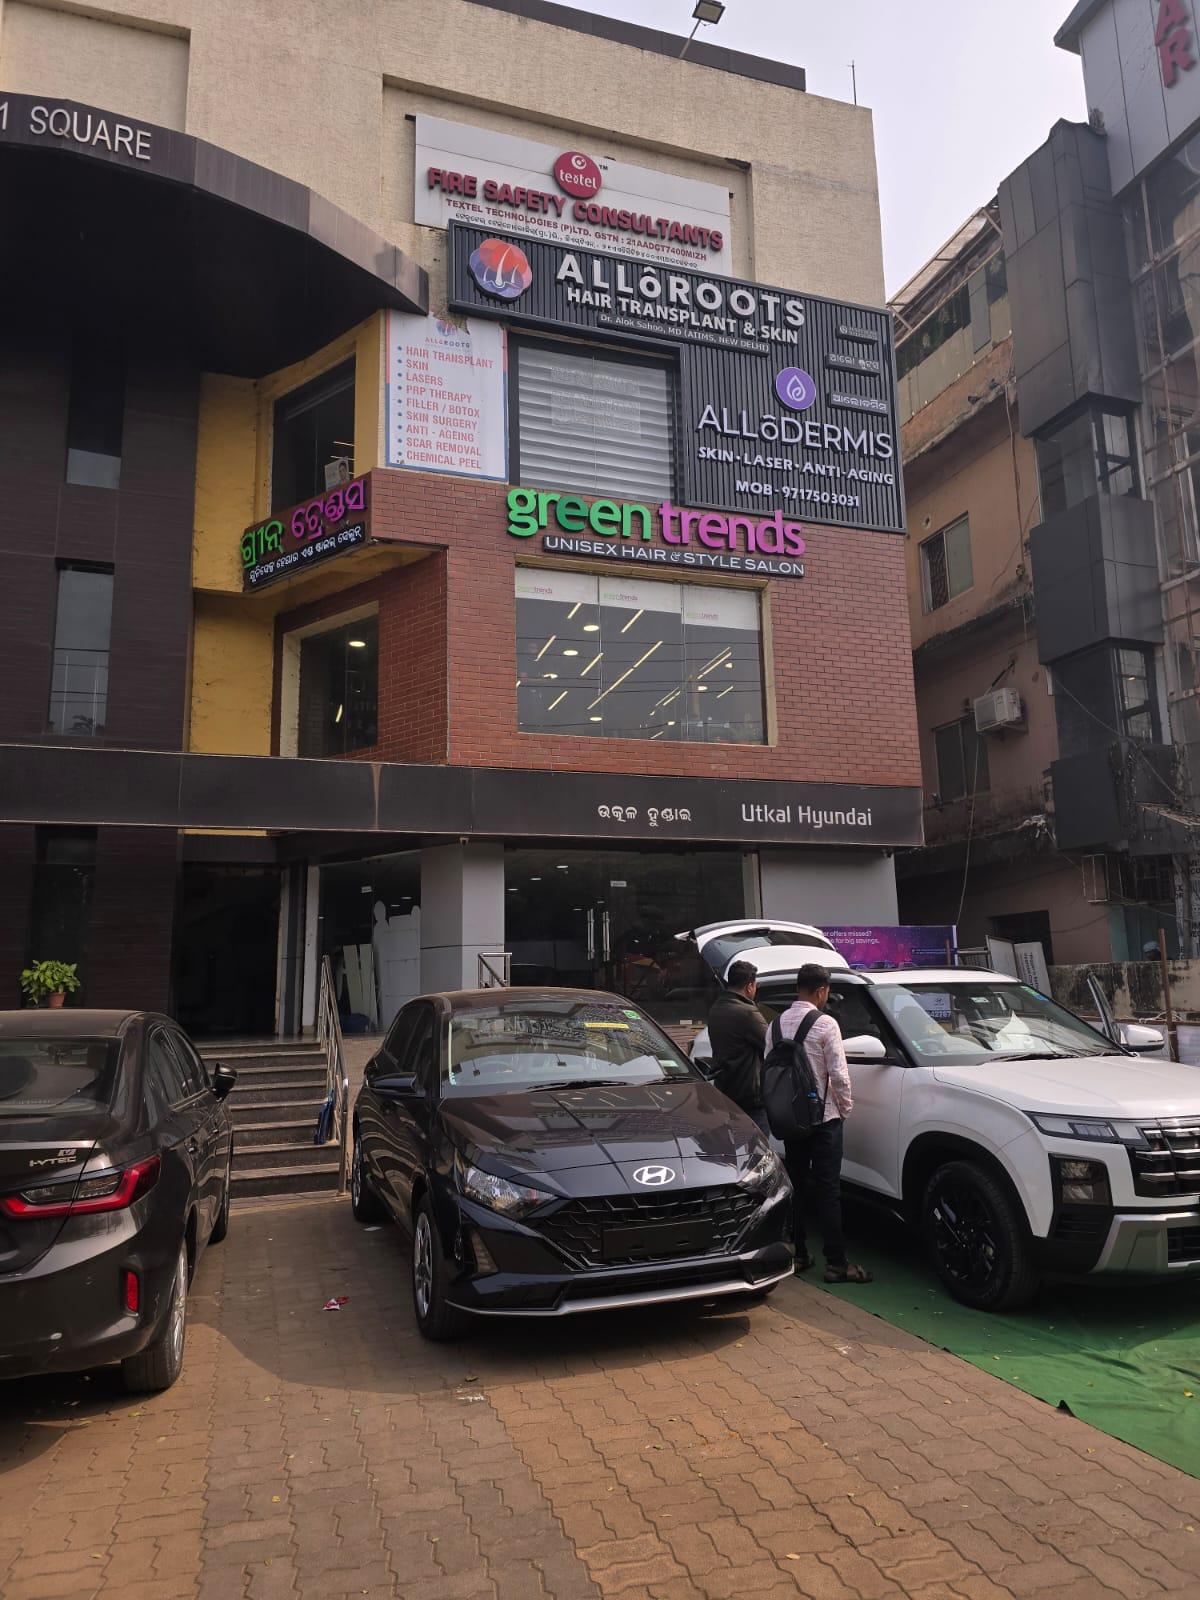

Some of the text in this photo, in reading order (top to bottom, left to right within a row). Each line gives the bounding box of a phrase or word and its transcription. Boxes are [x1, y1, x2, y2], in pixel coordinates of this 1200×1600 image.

[29, 106, 152, 161] SQUARE
[427, 167, 478, 199] FIRE
[484, 180, 567, 217] SAFETY
[573, 200, 724, 252] CONSULTANTS
[446, 198, 483, 213] TEXTEL
[485, 206, 558, 229] TECHNOLOGIES
[594, 231, 620, 243] GSTN
[567, 287, 798, 345] HAIR TRANSPLANT & SKIN
[600, 314, 613, 323] Dr.
[615, 317, 635, 327] Alok
[668, 326, 683, 336] MD
[718, 335, 739, 346] NEW
[406, 346, 494, 369] HAIR TRANSPLANT
[406, 359, 429, 371] SKIN
[406, 372, 443, 386] LASERS
[406, 385, 473, 404] PRP THERAPY
[406, 398, 439, 412] FILLER
[448, 406, 481, 418] BOTOX
[406, 411, 477, 430] SKIN SURGERY
[406, 425, 429, 436] ANTI
[439, 429, 474, 443] AGEING
[406, 438, 482, 457] SCAR REMOVAL
[406, 450, 482, 470] CHEMICAL PEEL
[507, 488, 807, 556] green trends
[545, 537, 619, 556] UNISEX
[622, 547, 667, 561] HAIR
[683, 553, 741, 569] STYLE
[745, 559, 805, 575] SALON
[741, 803, 873, 828] Utkal Hyundai
